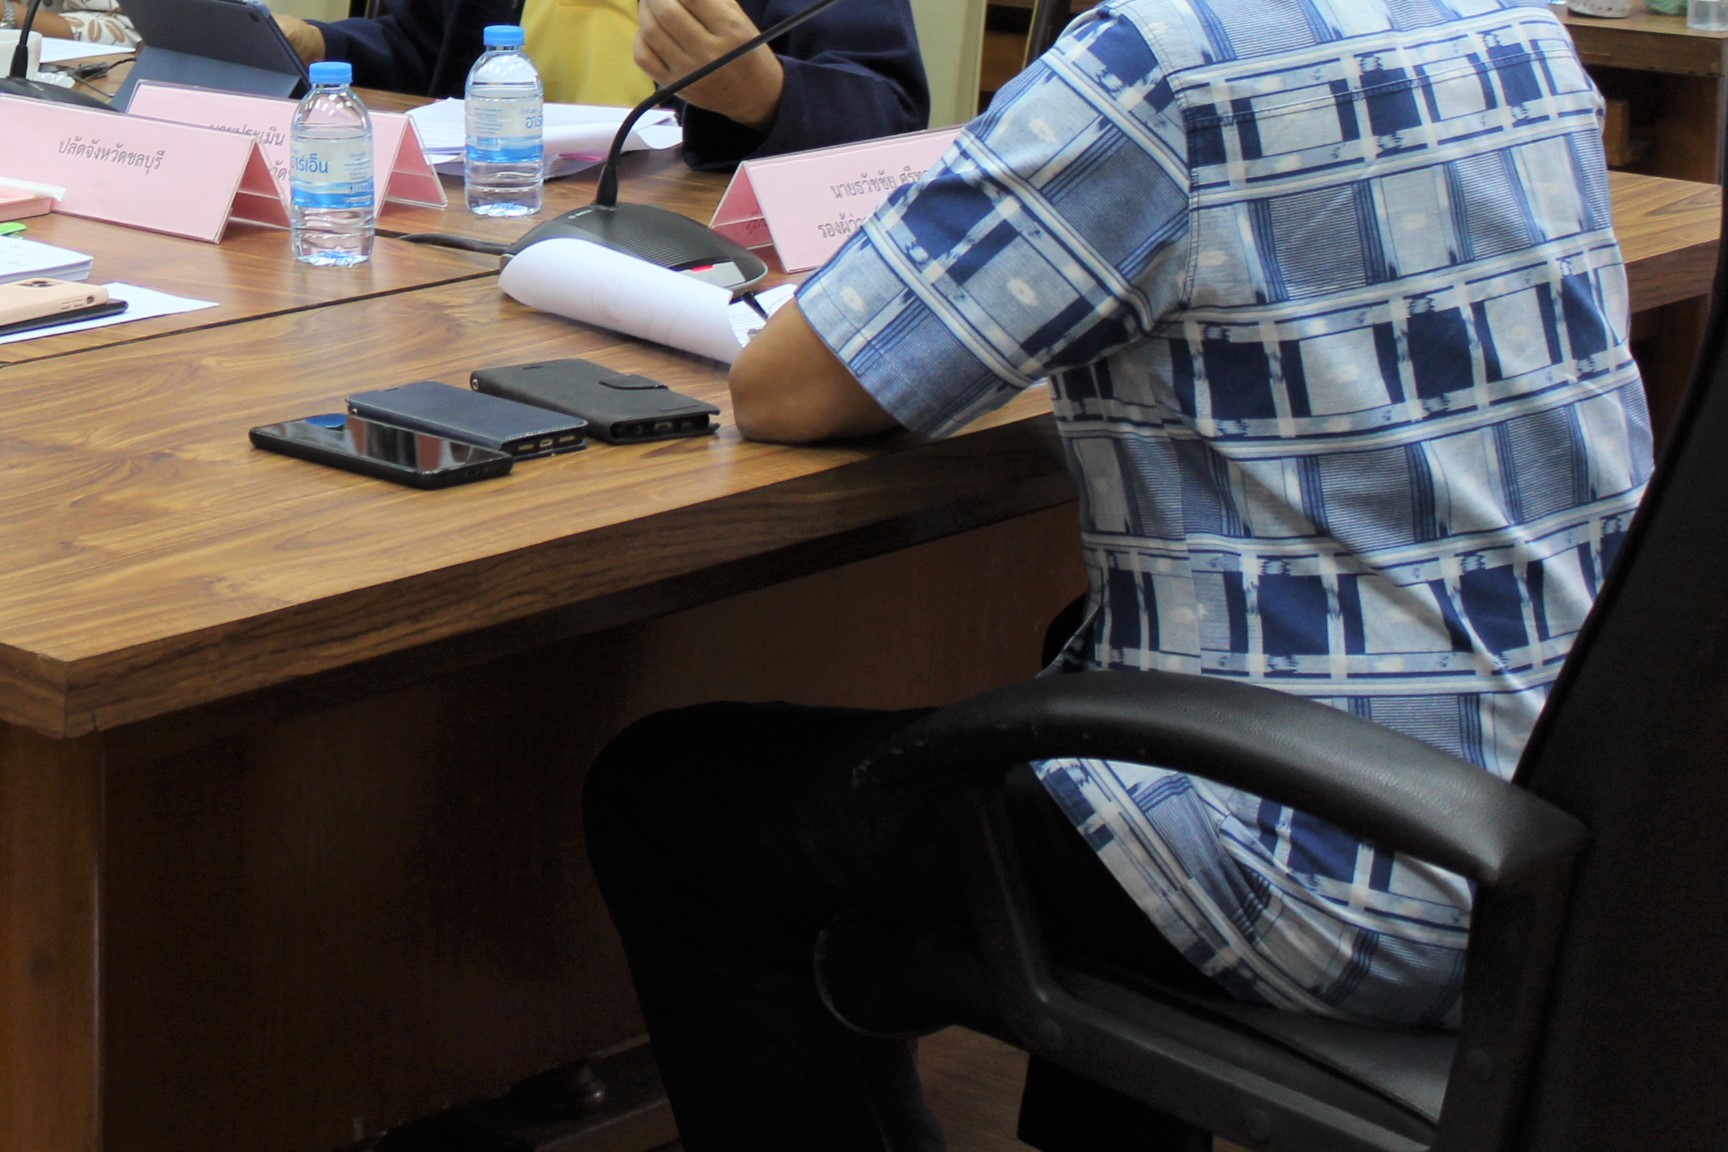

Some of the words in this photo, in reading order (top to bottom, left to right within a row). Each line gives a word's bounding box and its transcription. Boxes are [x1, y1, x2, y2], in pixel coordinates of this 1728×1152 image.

[58, 135, 166, 176] ปลัดจังหวัดชลบุรี
